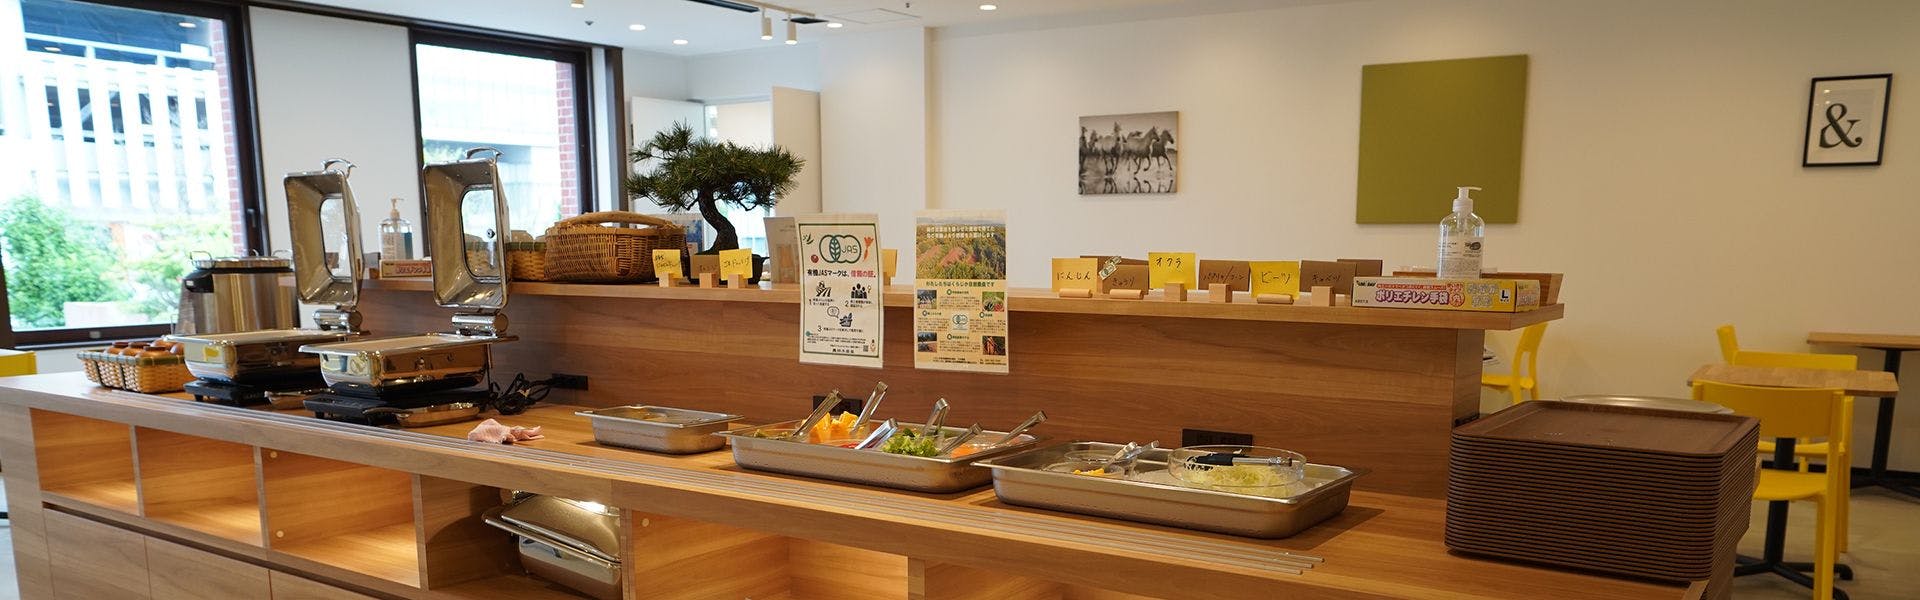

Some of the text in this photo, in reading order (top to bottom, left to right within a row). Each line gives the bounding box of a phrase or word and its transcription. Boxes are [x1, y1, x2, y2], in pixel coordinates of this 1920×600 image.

[1819, 103, 1863, 148] &
[842, 244, 858, 254] JAS
[1156, 257, 1181, 268] オクラ
[1056, 271, 1091, 280] にんじん
[1111, 275, 1135, 287] きゅうり
[1261, 270, 1291, 284] ビーツ
[1375, 289, 1449, 304] ポリエチレン手袋
[1502, 290, 1509, 298] L
